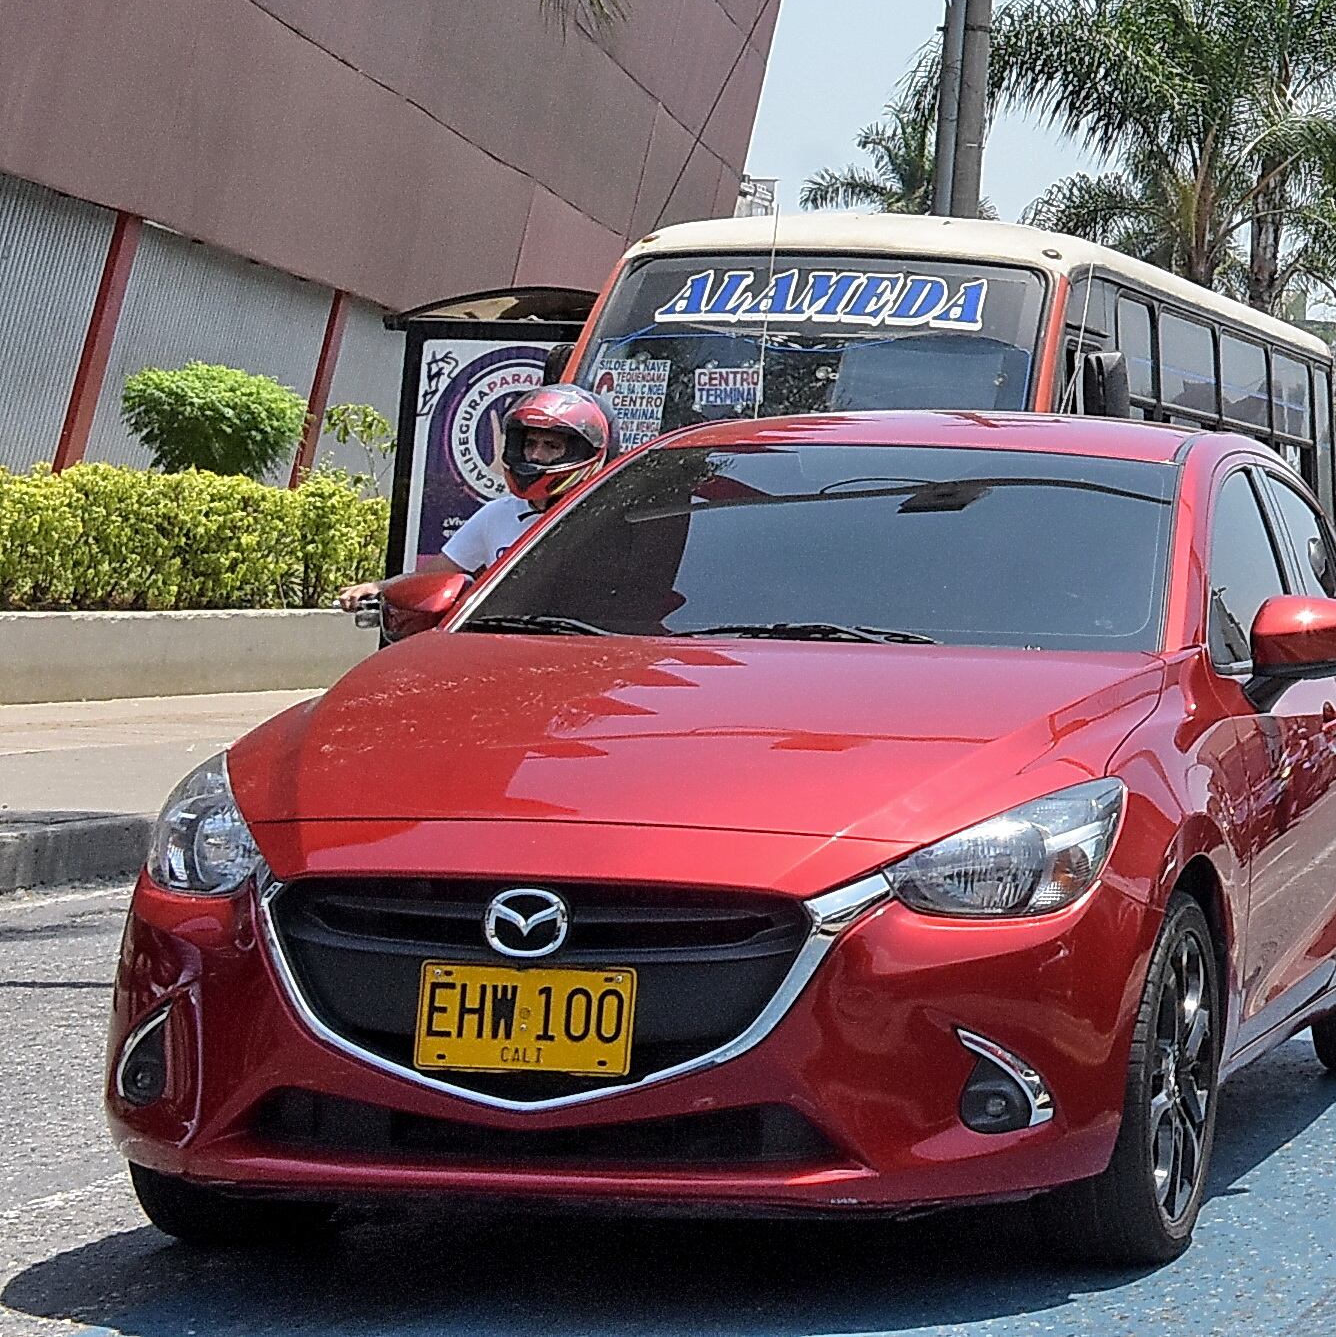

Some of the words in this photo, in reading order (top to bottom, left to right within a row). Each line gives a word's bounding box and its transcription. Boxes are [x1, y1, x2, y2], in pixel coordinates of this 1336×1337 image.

[655, 270, 988, 331] ALAMEDA
[617, 372, 667, 383] TEQUENDAMA
[698, 370, 760, 387] CENTRO
[612, 395, 663, 408] CENTRO
[426, 981, 519, 1041] EHW
[535, 985, 625, 1044] 100
[499, 1046, 543, 1064] CALI
